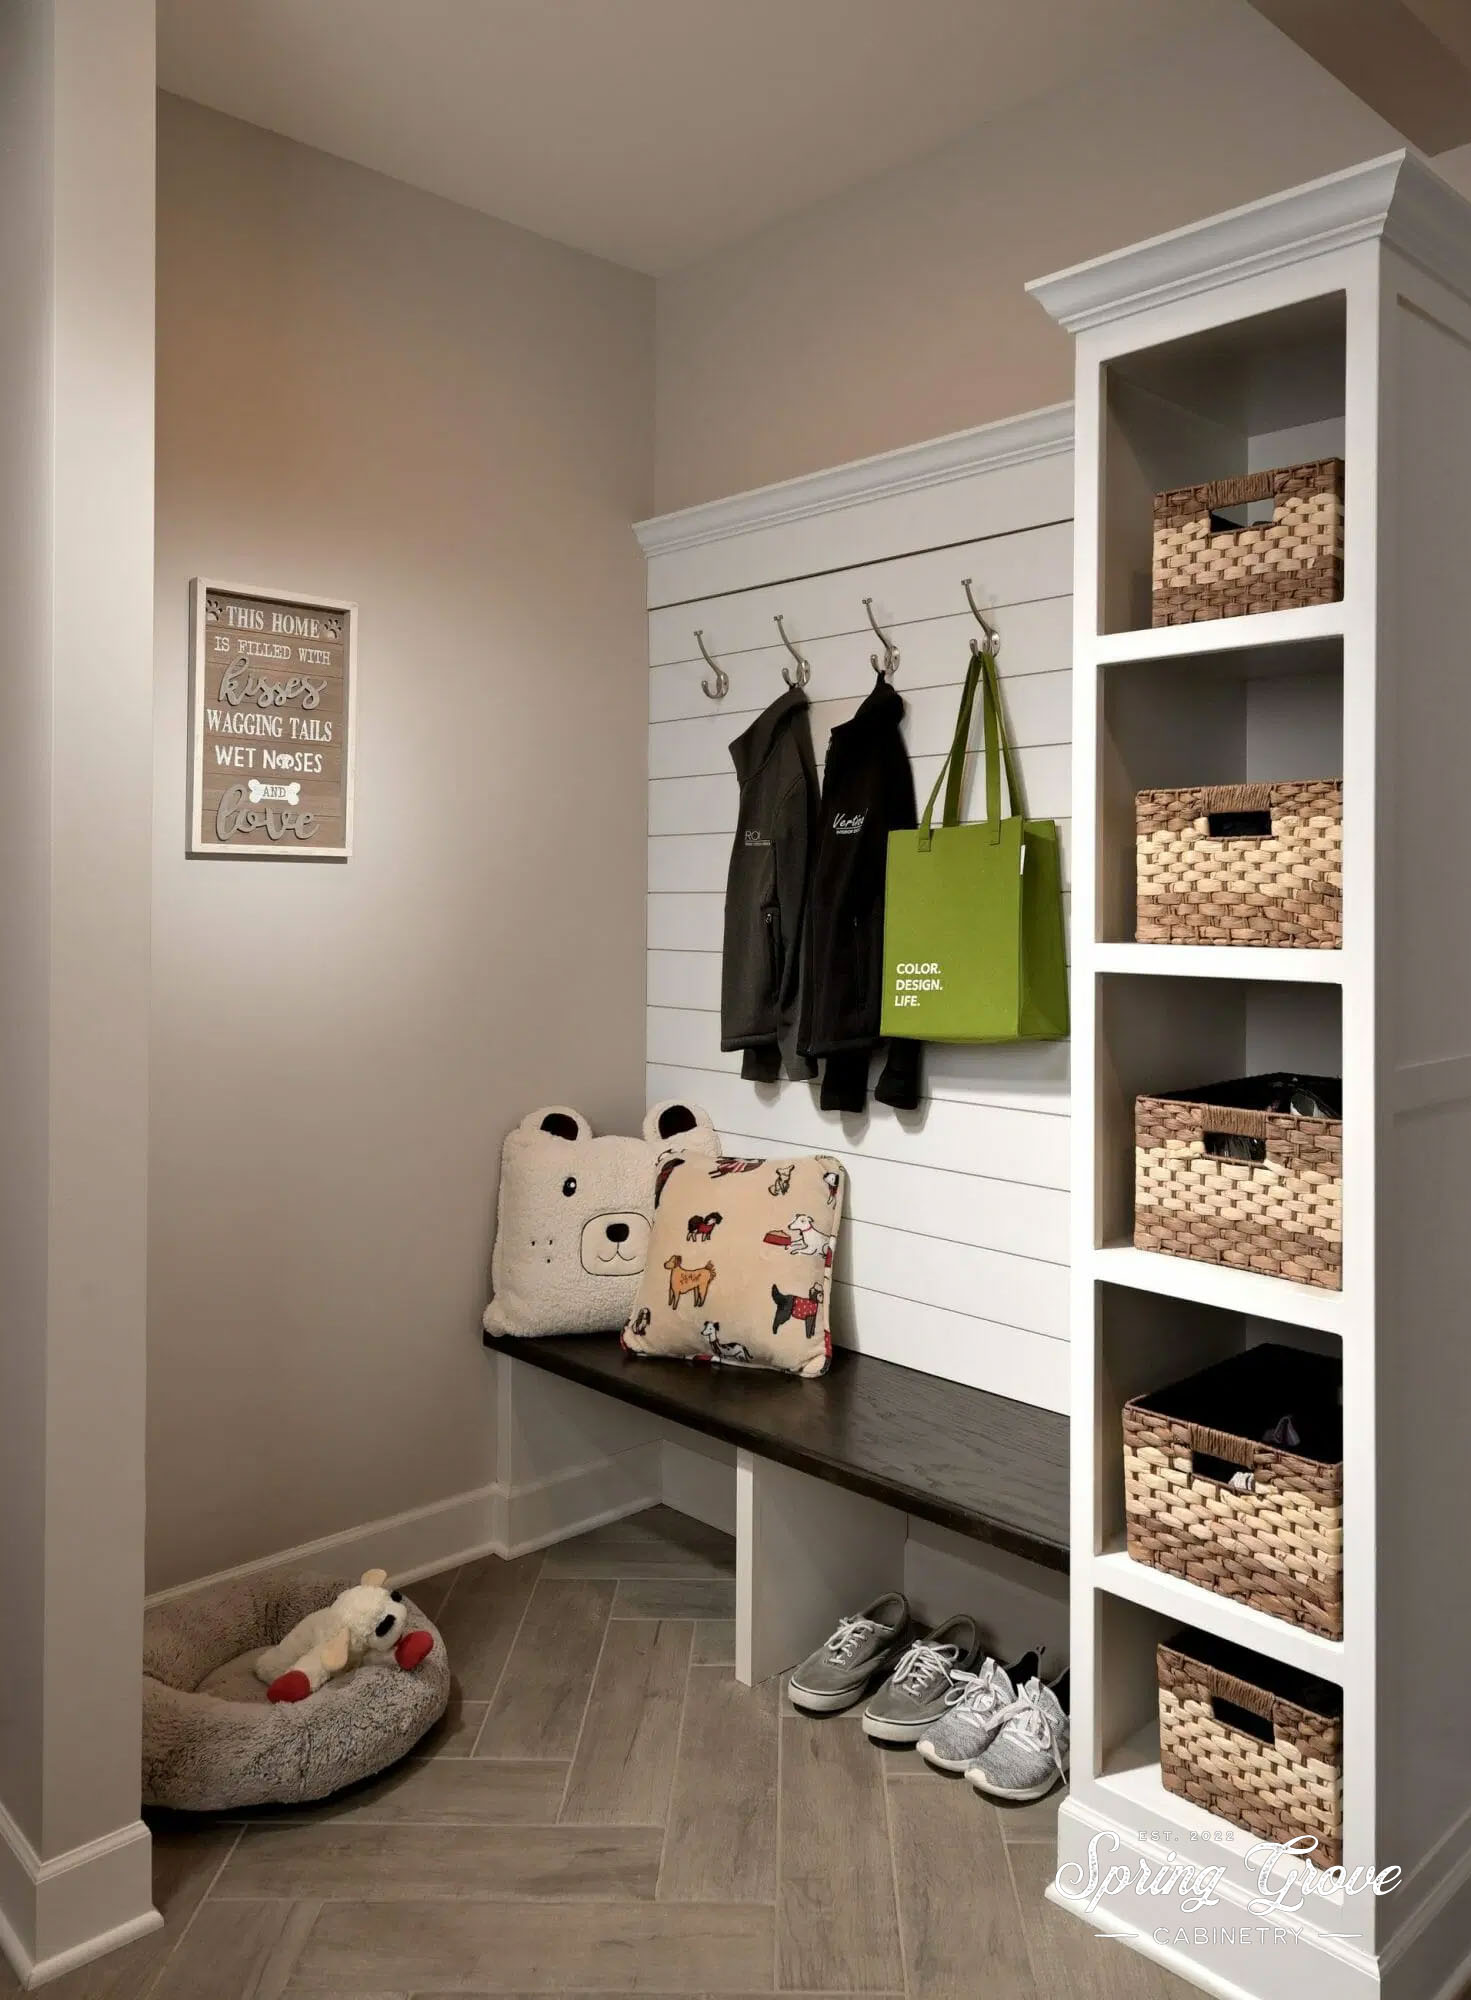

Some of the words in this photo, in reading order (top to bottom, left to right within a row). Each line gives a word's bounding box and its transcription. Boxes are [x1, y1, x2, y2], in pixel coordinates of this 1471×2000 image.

[226, 605, 264, 631] THIS
[272, 612, 320, 639] HOME
[214, 636, 230, 652] IS
[238, 639, 291, 660] FILLED
[299, 648, 331, 665] WITH
[219, 657, 328, 709] kisses
[207, 709, 282, 737] WAGGING
[290, 718, 332, 742] TAILS
[215, 745, 257, 768] WET
[263, 786, 286, 798] AND
[216, 784, 320, 841] love
[896, 963, 942, 975] COLOR.
[895, 979, 943, 991] DESIGN.
[894, 995, 920, 1007] LIFE.
